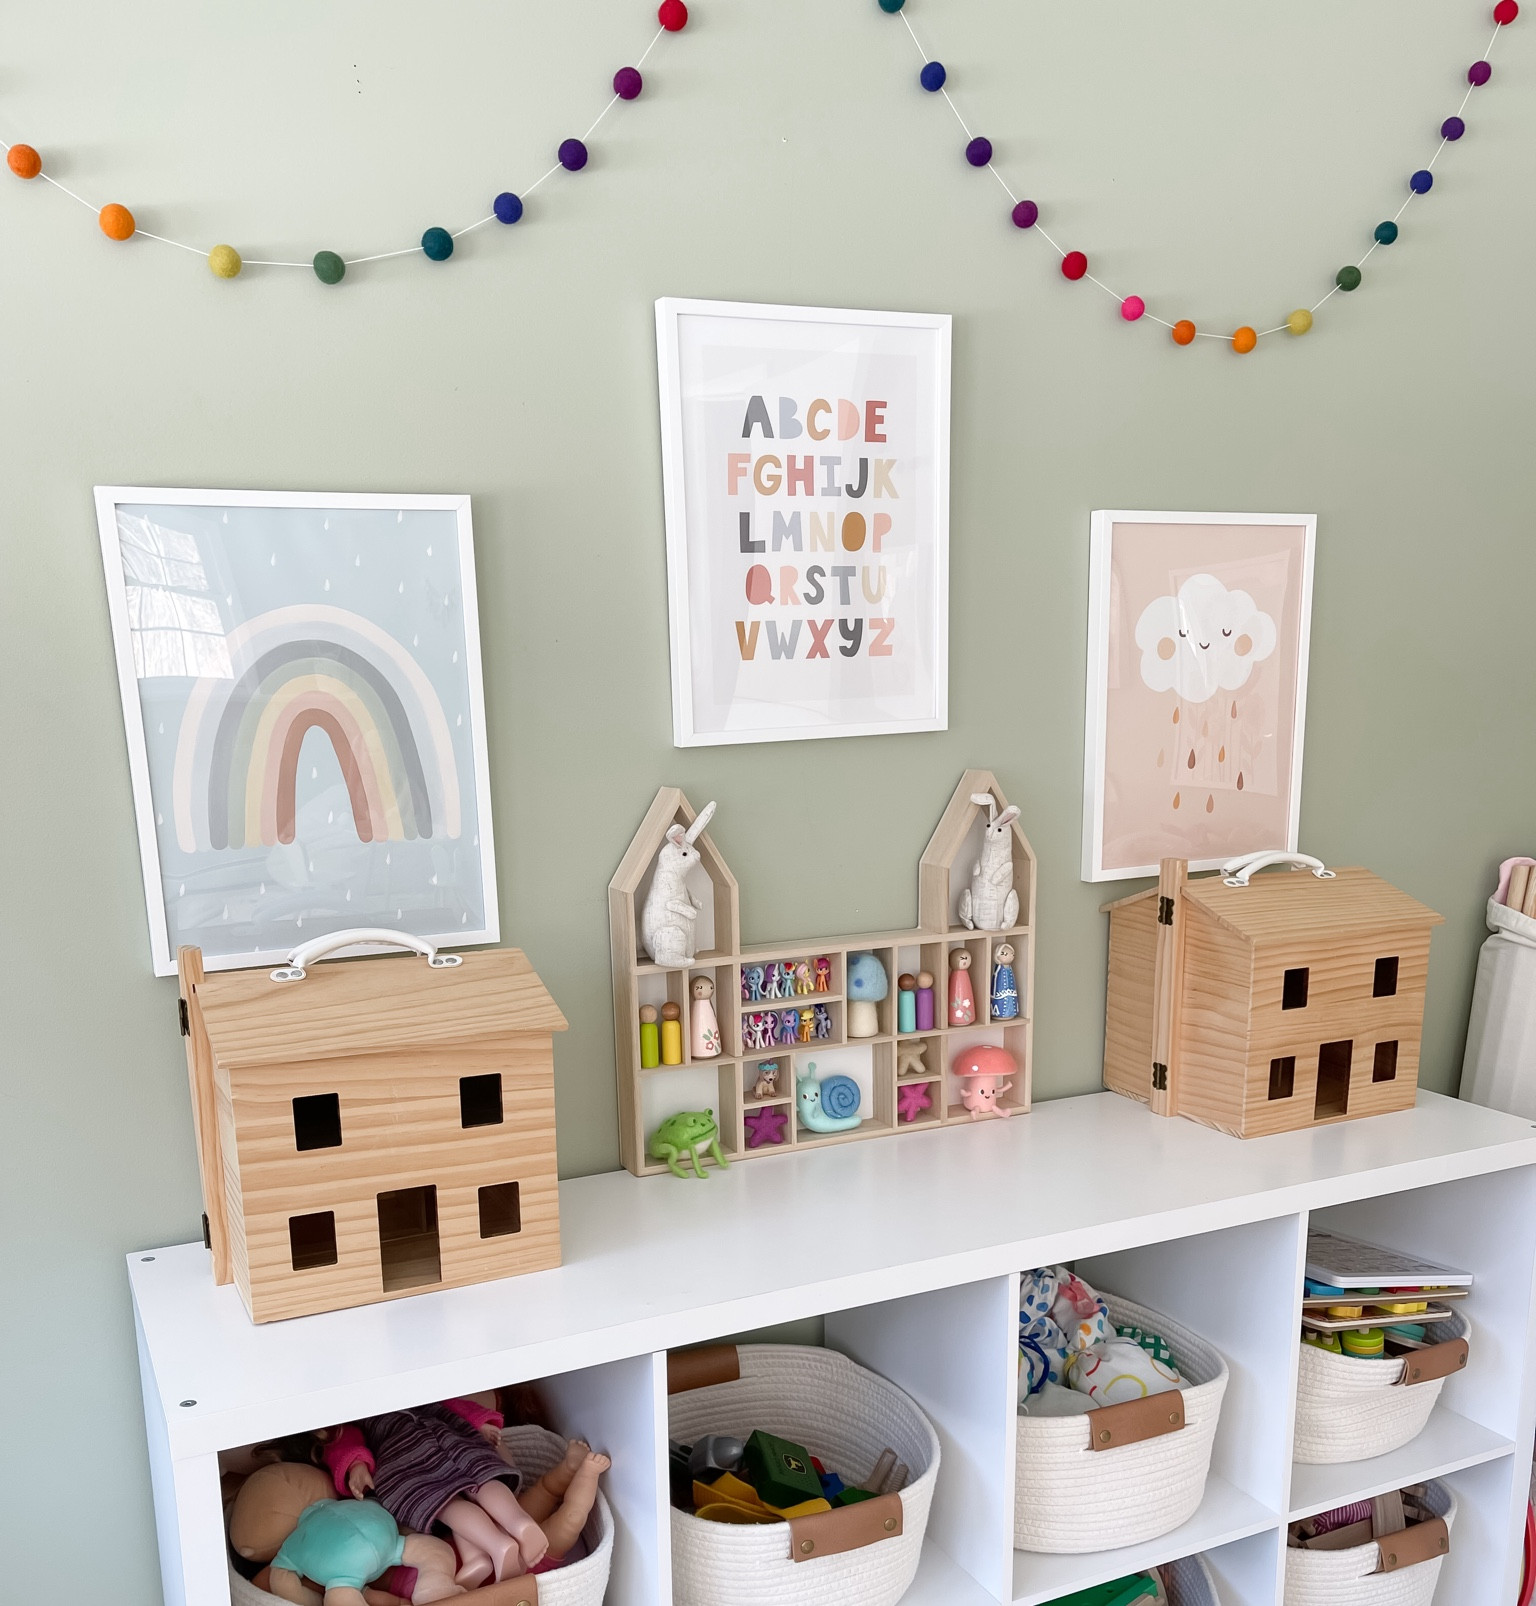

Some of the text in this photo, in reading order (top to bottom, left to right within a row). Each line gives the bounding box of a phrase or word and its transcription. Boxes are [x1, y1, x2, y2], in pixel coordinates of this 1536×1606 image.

[741, 395, 887, 442] ABCDE
[727, 453, 900, 498] FGHIJK
[739, 511, 892, 553] LMNOP
[745, 564, 886, 605] QRSTU
